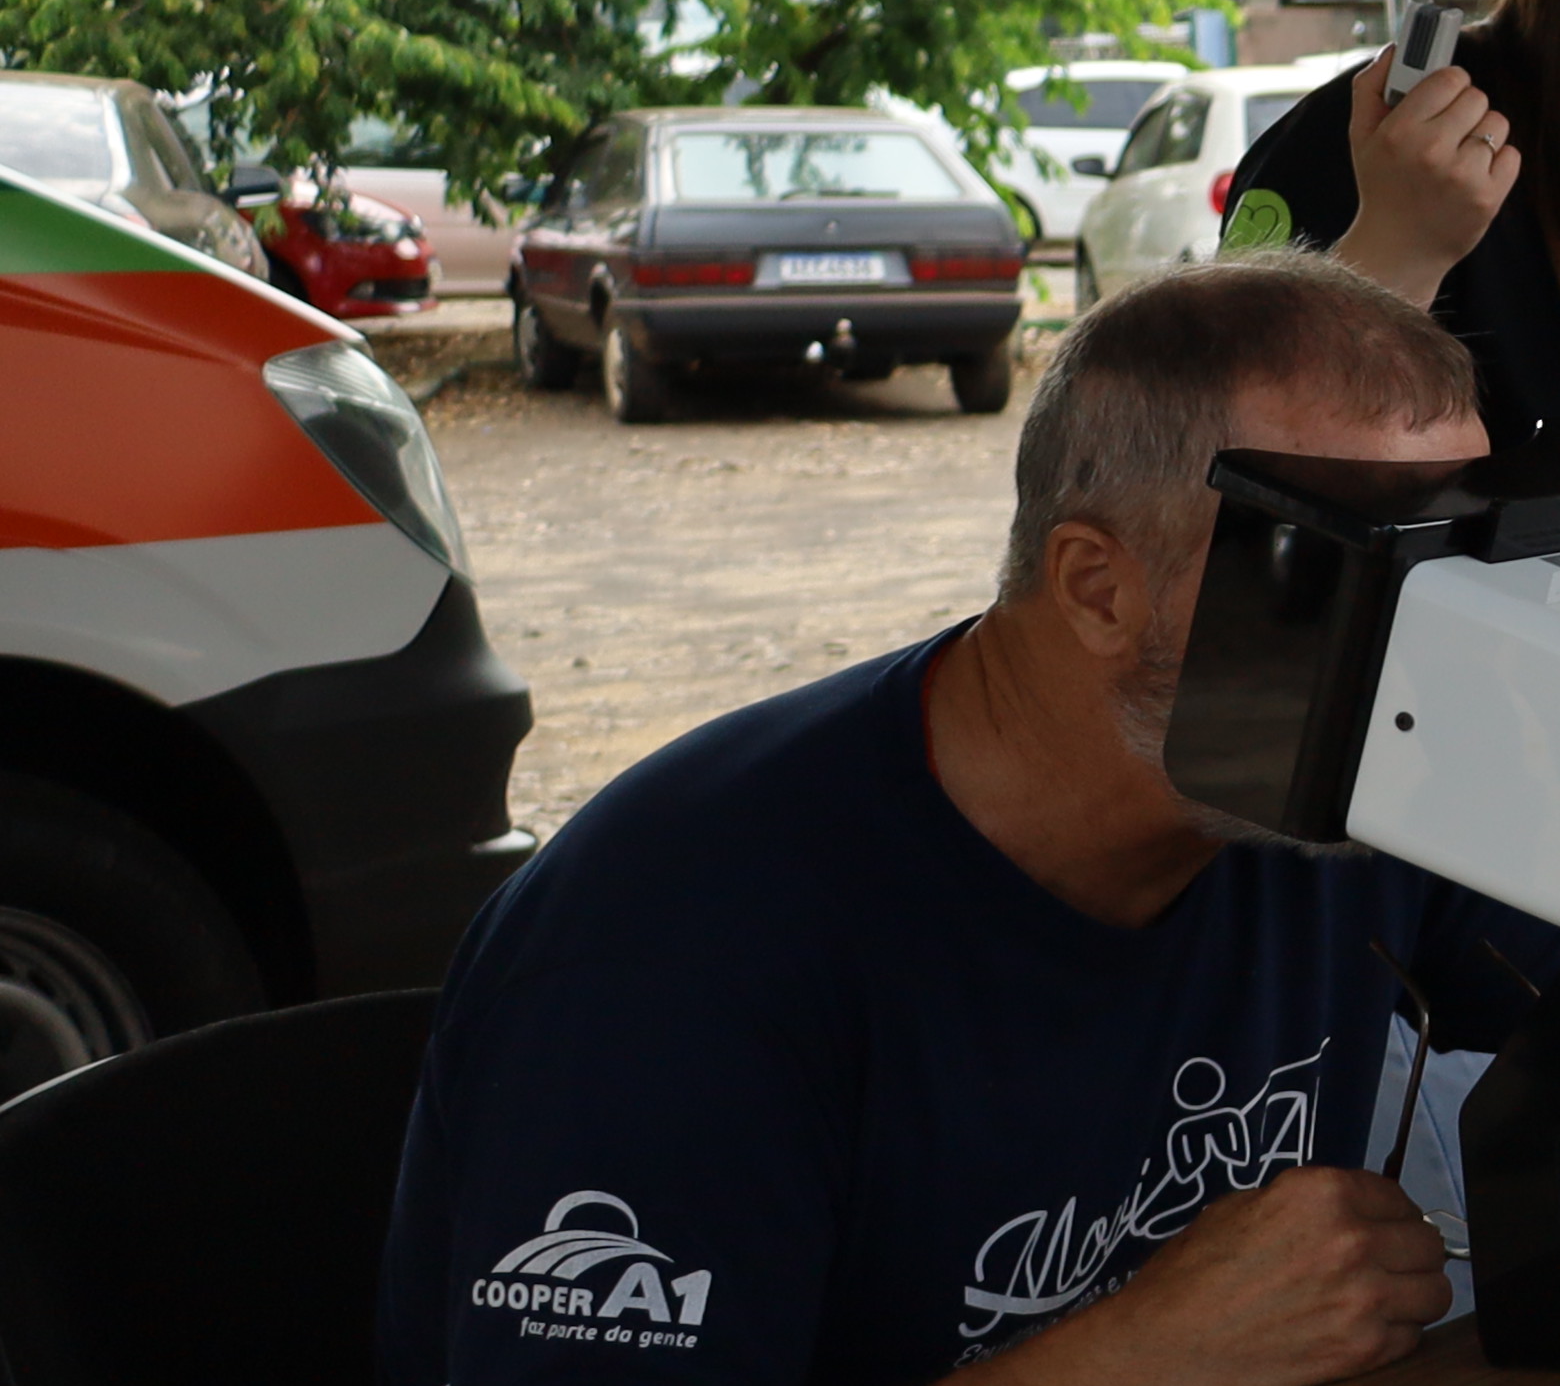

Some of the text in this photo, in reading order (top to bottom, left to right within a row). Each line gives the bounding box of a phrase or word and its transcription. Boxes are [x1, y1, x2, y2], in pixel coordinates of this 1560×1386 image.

[471, 1261, 713, 1327] COOPER A1
[519, 1316, 699, 1349] faz parte da gente
